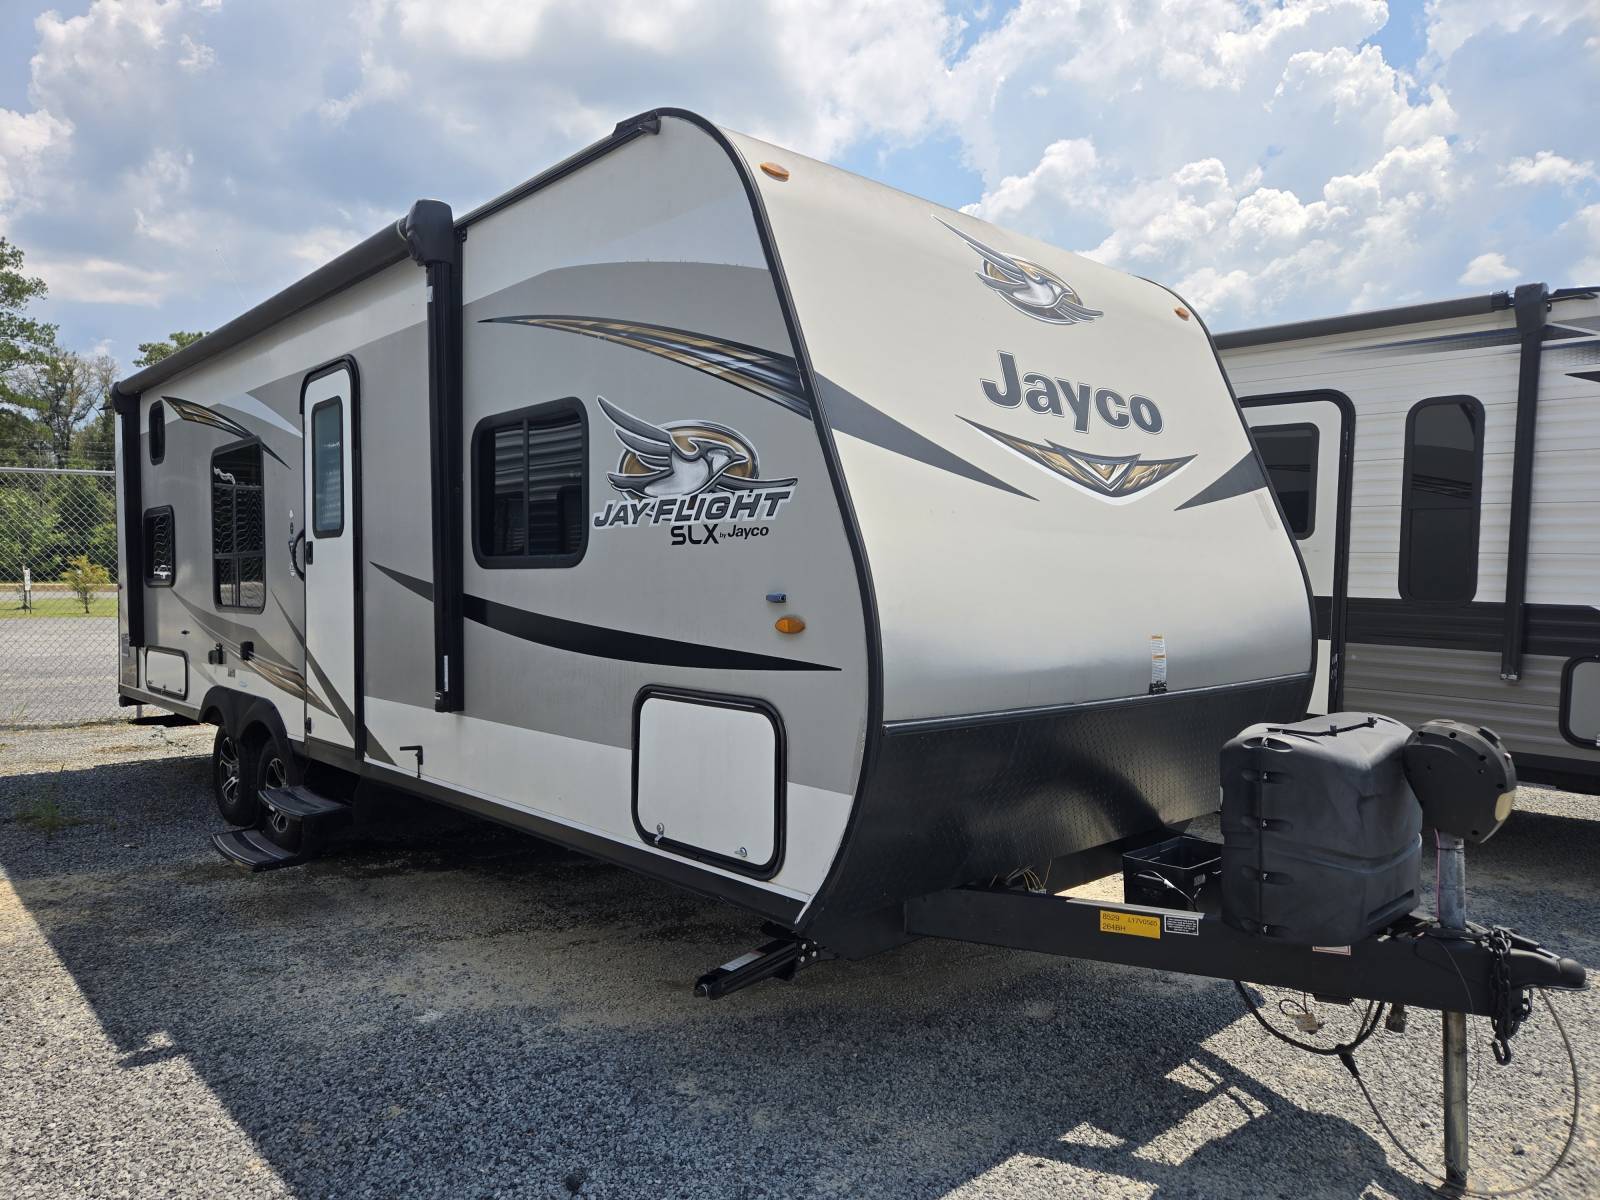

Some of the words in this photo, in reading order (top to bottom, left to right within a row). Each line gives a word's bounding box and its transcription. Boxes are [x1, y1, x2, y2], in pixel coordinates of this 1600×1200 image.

[980, 350, 1164, 435] Jayco
[671, 524, 719, 545] SLX
[728, 524, 769, 540] Jayco
